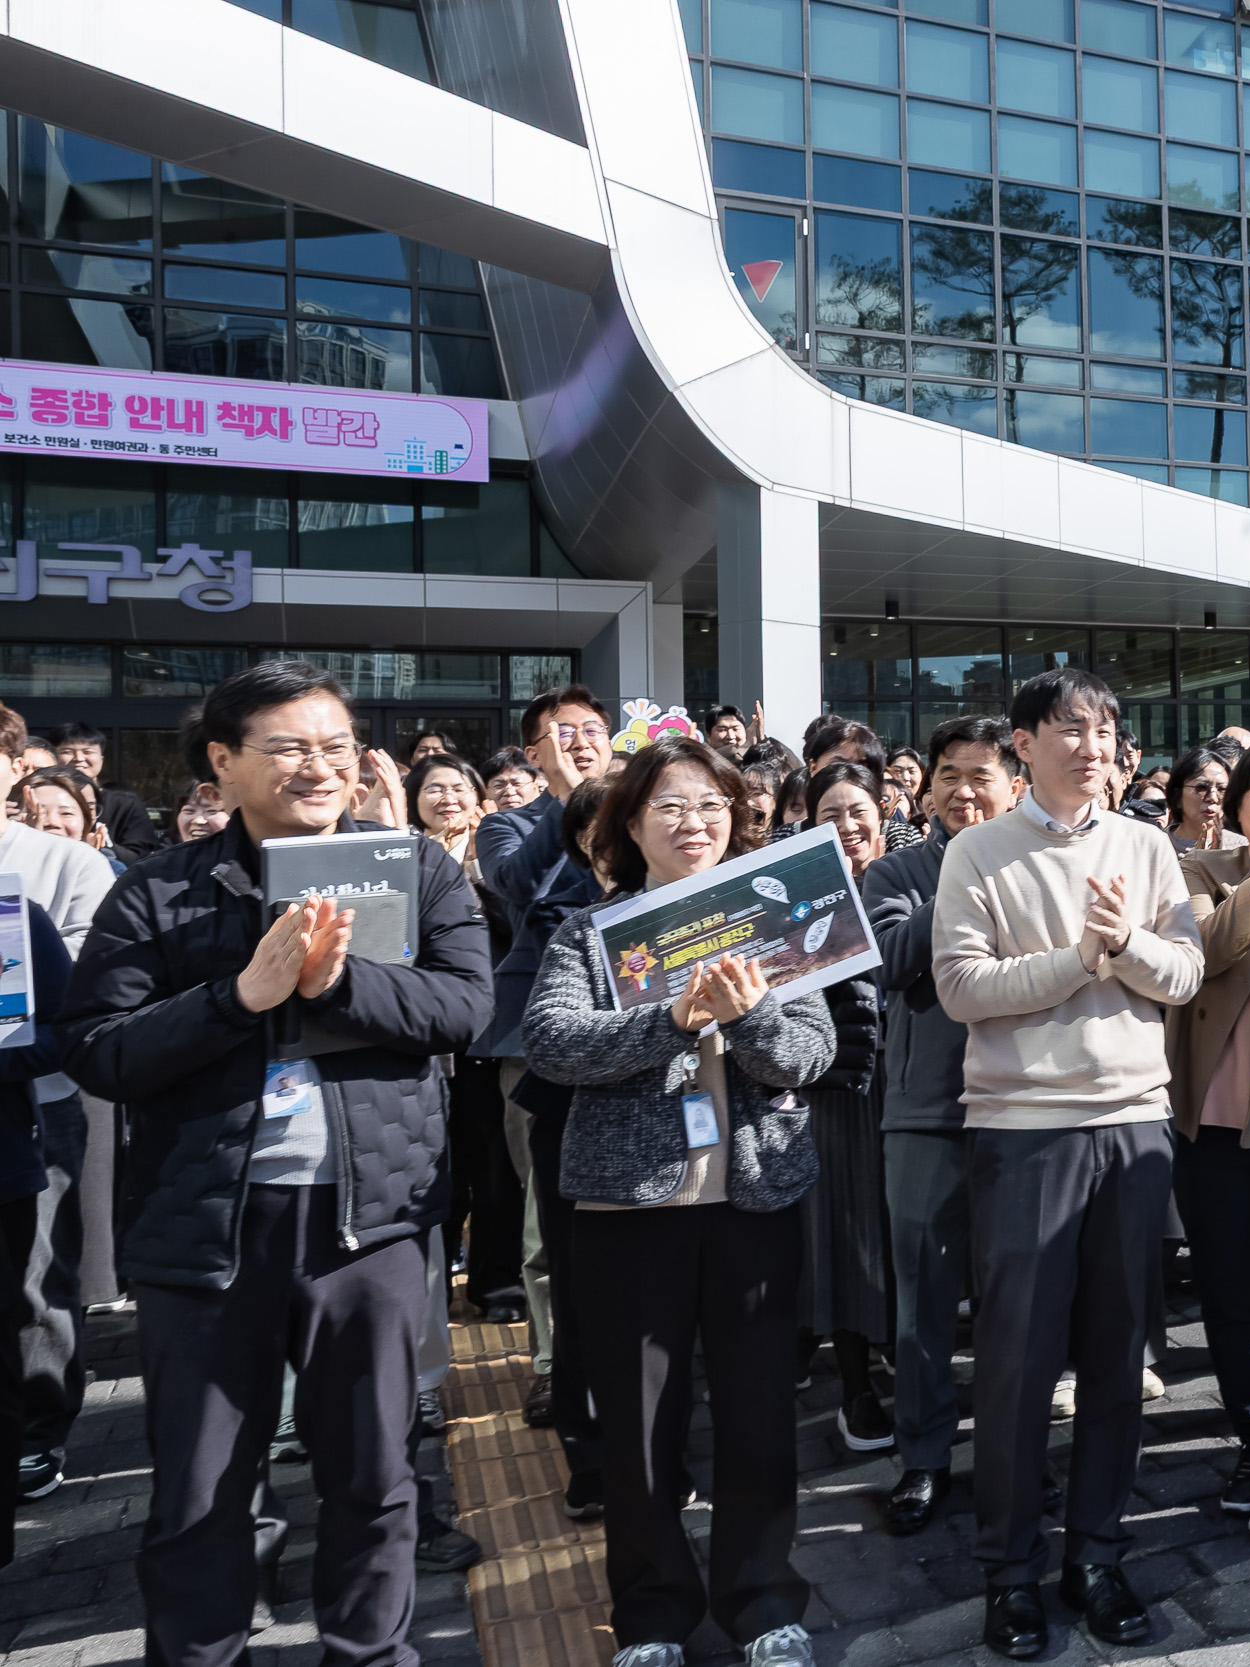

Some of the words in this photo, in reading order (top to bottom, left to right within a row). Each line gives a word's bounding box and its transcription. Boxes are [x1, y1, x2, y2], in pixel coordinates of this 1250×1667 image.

[28, 387, 113, 428] 종합
[124, 394, 205, 435] 안내
[216, 401, 293, 440] 책자
[302, 406, 380, 448] 발간
[4, 433, 41, 446] 보건소
[44, 436, 80, 449] 민원실
[90, 439, 149, 453] 민원여권과
[159, 444, 170, 455] 동
[173, 445, 218, 458] 주민센터
[810, 888, 848, 911] 광진구
